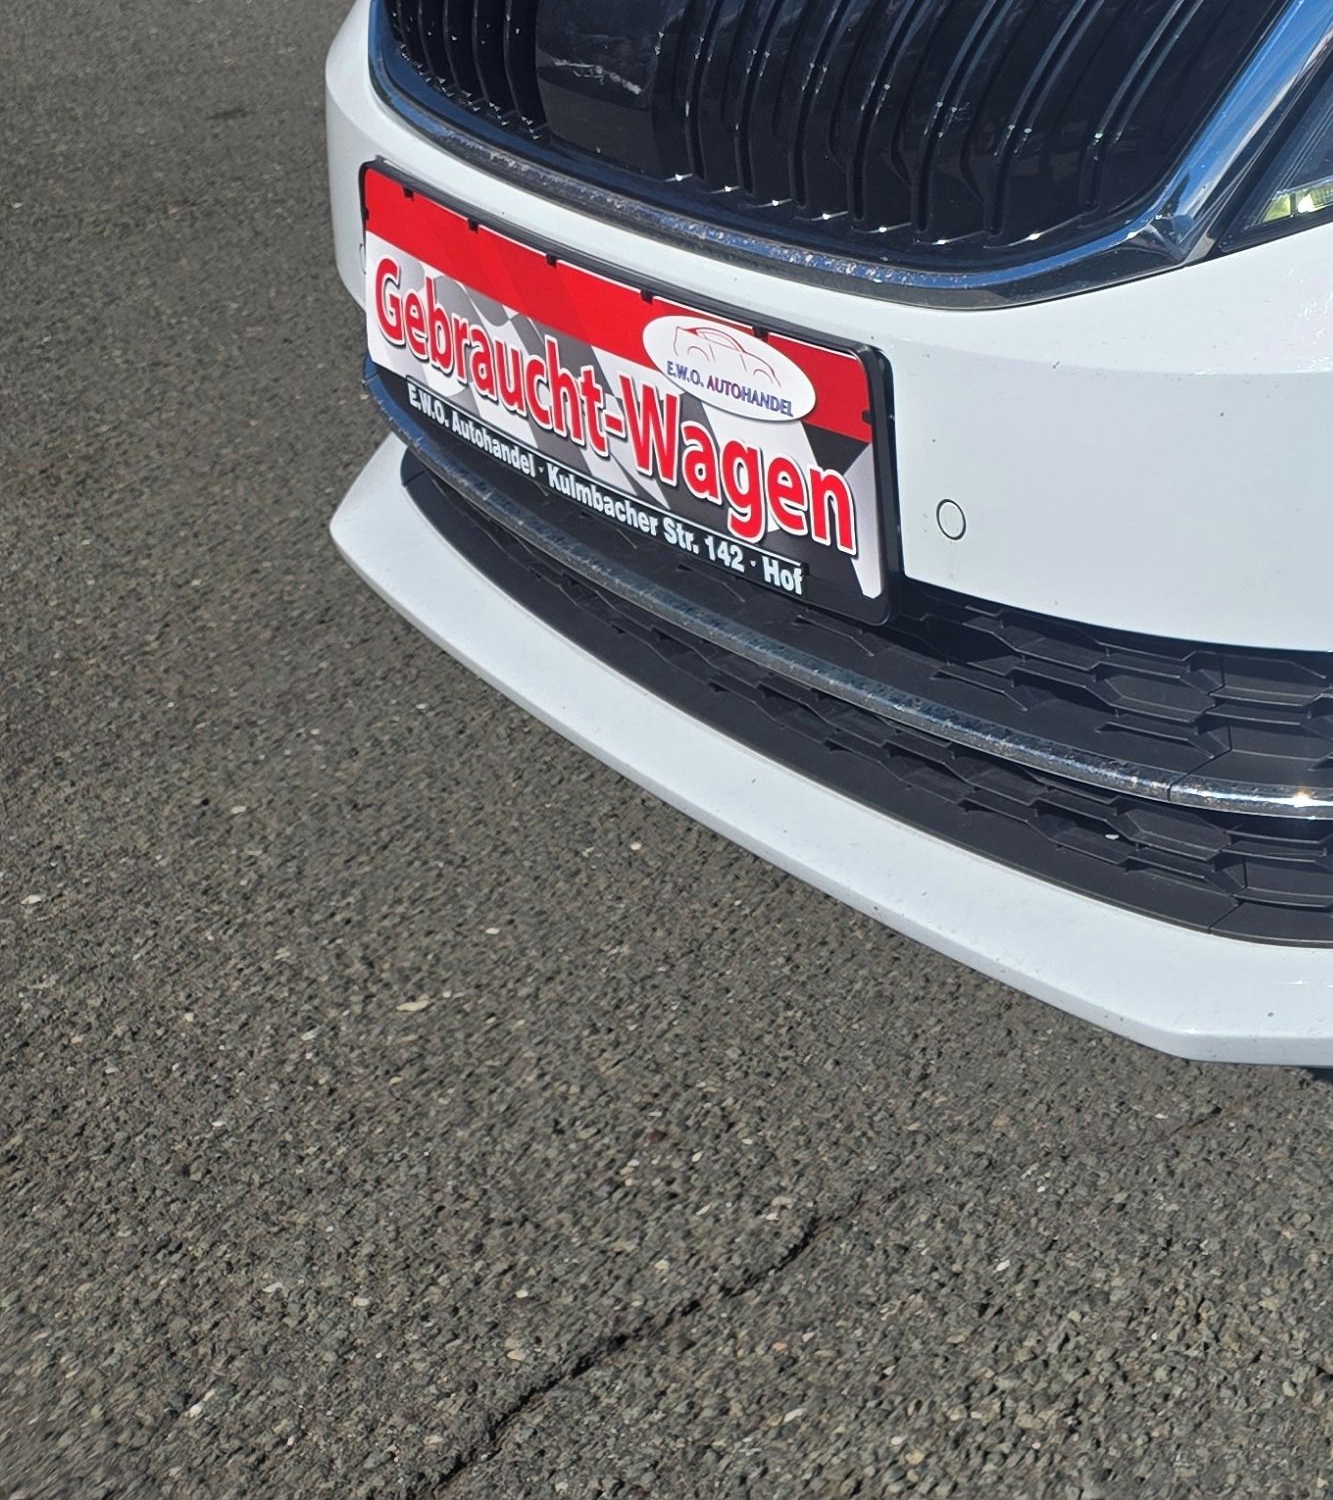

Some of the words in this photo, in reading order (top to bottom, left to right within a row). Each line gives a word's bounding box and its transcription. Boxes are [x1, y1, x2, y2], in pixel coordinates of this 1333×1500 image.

[374, 255, 857, 555] Gebraucht-Wagen
[407, 384, 451, 428] E.W.O.
[451, 410, 536, 478] Autohandel
[547, 462, 659, 536] Kulmbacher
[662, 516, 701, 555] Str.
[704, 534, 745, 573] 142
[762, 555, 803, 594] Hof
[666, 360, 705, 388] E.W.O.
[706, 375, 795, 418] AUTOHANDEL
